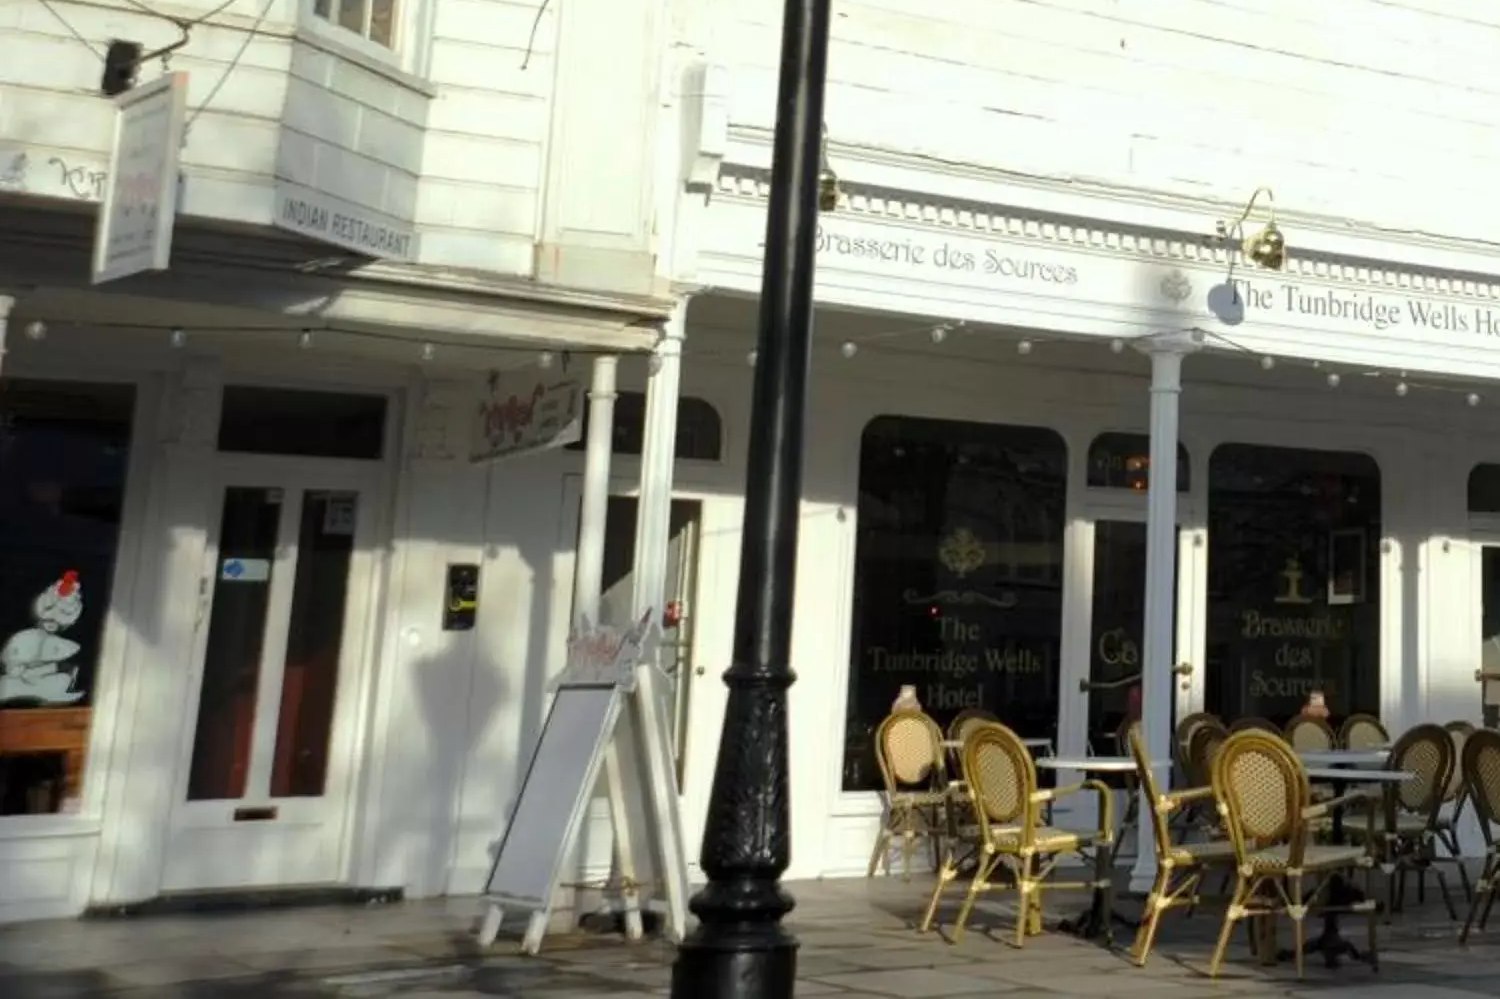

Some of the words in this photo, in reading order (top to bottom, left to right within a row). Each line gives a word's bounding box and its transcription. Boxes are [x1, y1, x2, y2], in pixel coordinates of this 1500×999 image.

[283, 198, 329, 231] INDIAN
[331, 212, 412, 257] RESTAURANT
[933, 241, 976, 272] des
[982, 248, 1079, 285] Sources
[1232, 278, 1273, 310] The
[1281, 284, 1401, 330] Tunbridge
[1407, 301, 1470, 333] Wells
[937, 616, 981, 641] The
[867, 646, 979, 679] Tunbridge
[984, 648, 1042, 673] Wells
[1275, 643, 1312, 669] des
[927, 683, 984, 709] Hotel
